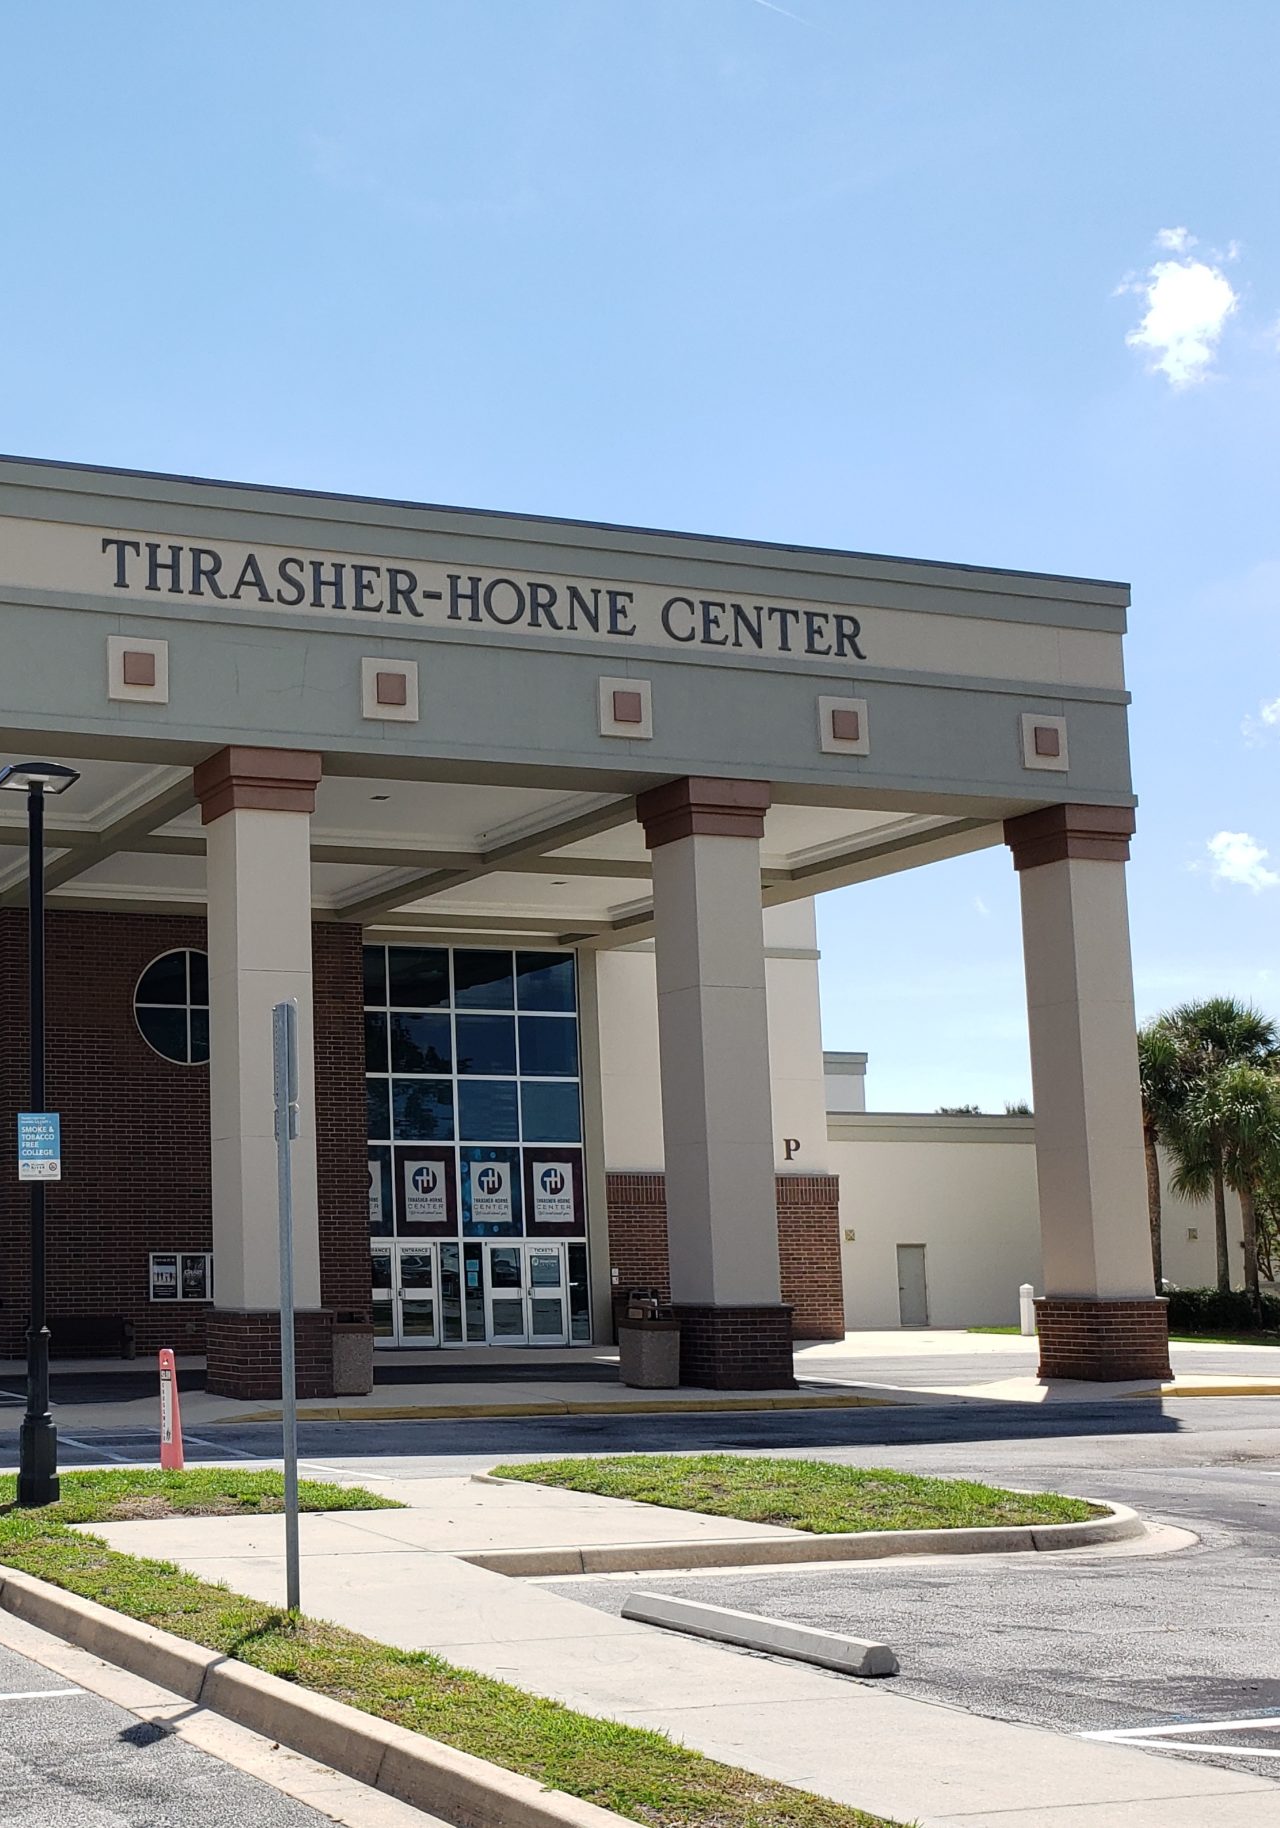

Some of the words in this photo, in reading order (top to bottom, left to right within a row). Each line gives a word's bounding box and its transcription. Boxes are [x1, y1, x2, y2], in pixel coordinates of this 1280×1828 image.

[101, 538, 636, 636] THRASHER-HORNE
[661, 597, 867, 660] CENTER
[783, 1138, 801, 1161] P
